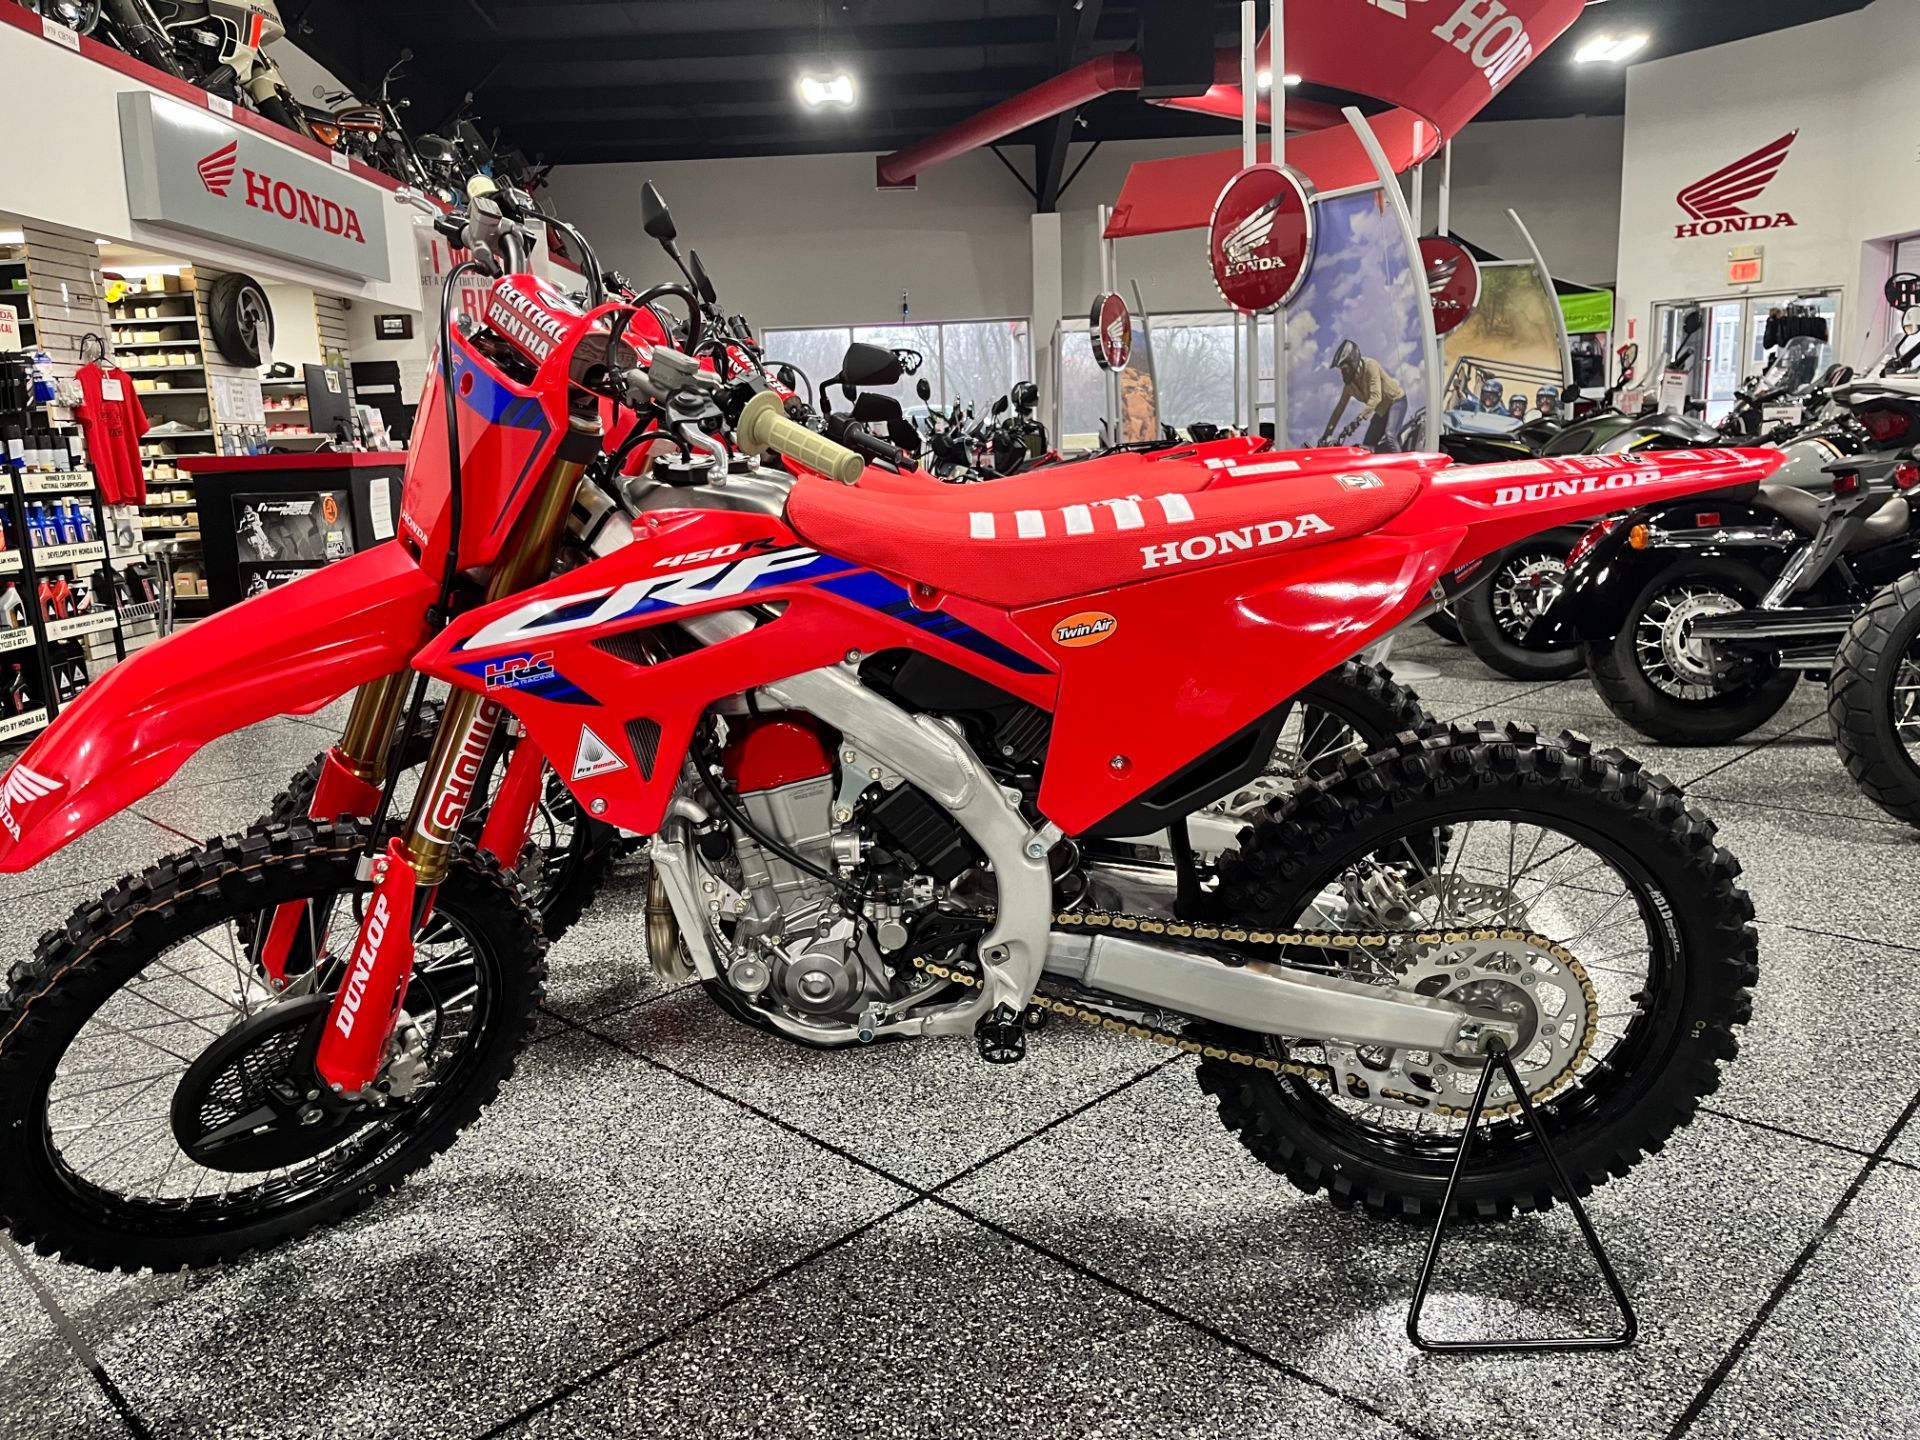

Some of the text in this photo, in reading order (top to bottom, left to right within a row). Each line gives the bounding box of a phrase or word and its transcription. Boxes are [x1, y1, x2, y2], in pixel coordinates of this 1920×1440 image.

[242, 168, 366, 244] HONDA
[1674, 212, 1798, 238] HONDA
[1224, 256, 1287, 277] HONDA
[488, 301, 554, 361] RENTHA
[496, 282, 570, 344] RENTHAL
[1492, 471, 1662, 506] DUNLOP
[402, 509, 429, 546] HONDA
[1139, 513, 1335, 570] HONDA
[653, 536, 777, 569] 450R
[463, 547, 821, 650] CRF
[1057, 618, 1115, 643] Twin Air
[485, 650, 555, 688] HRC
[577, 759, 617, 775] Pro Honda
[335, 893, 391, 1039] DUNLOP
